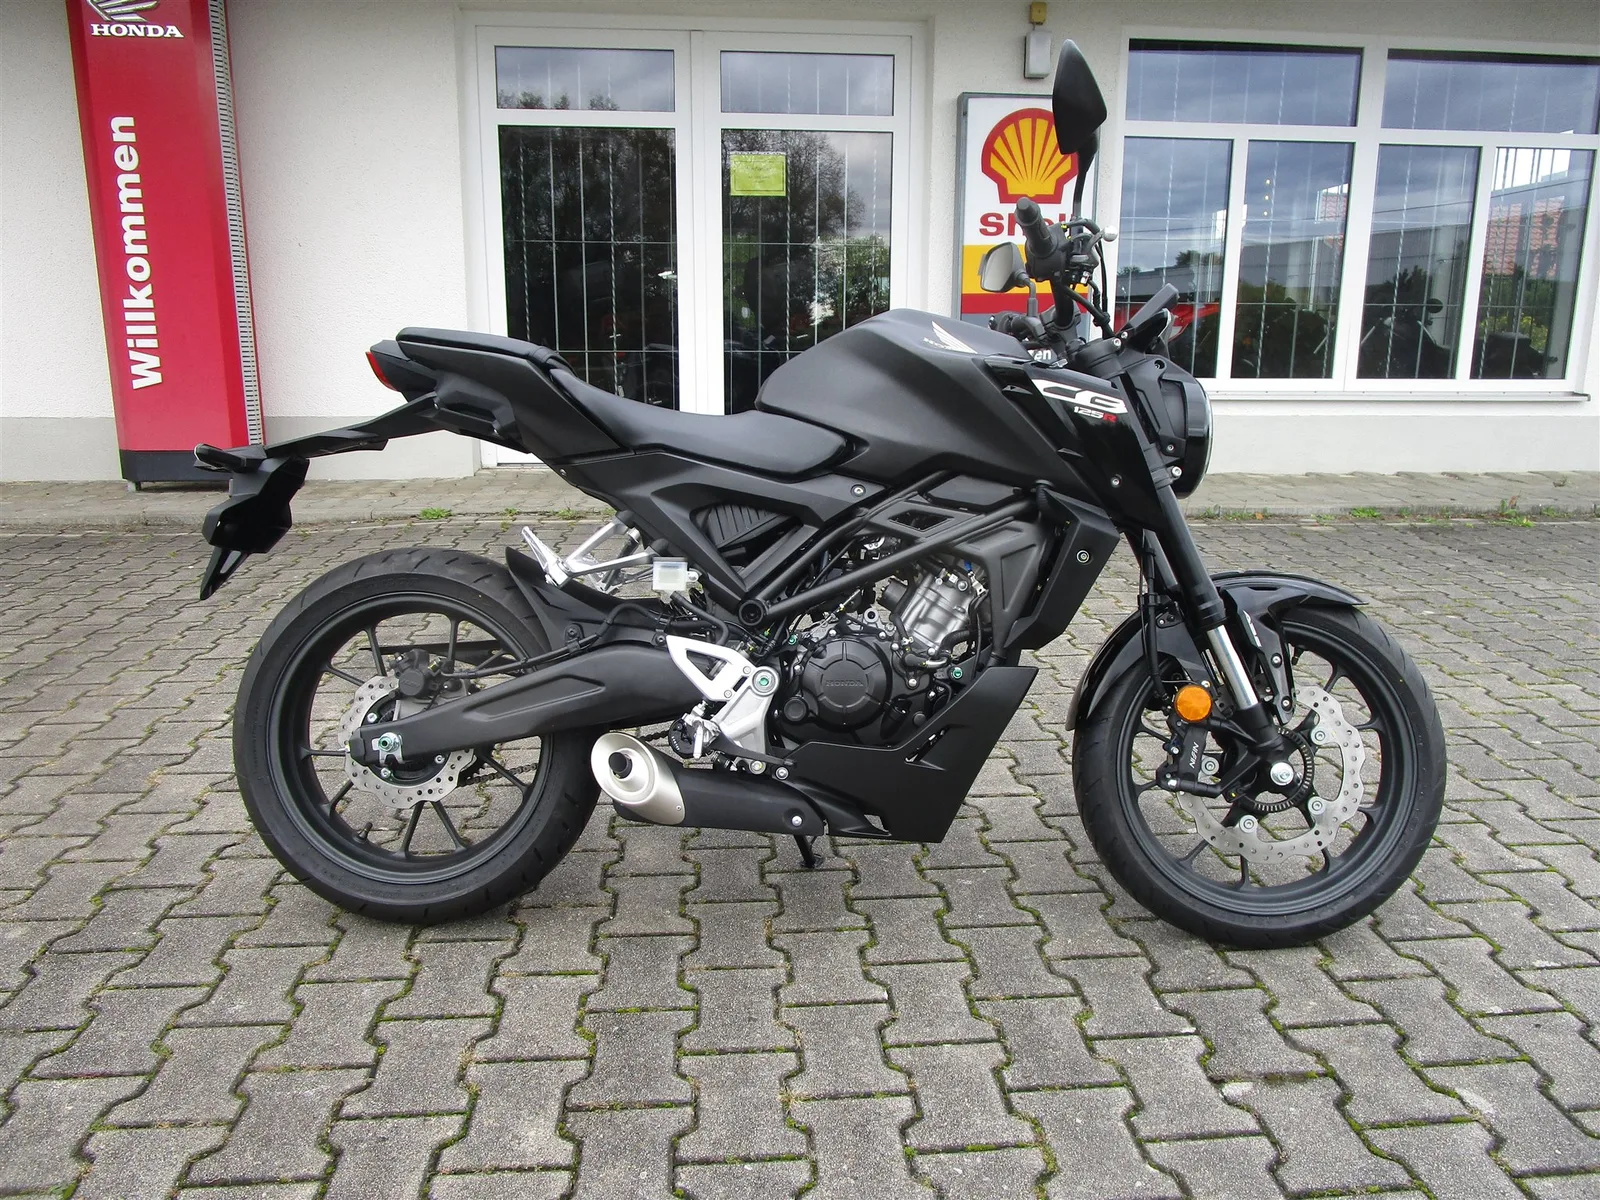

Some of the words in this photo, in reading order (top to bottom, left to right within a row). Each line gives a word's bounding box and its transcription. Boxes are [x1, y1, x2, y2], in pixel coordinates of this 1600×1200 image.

[91, 24, 184, 38] HONDA
[110, 116, 163, 390] Willkommen
[1074, 406, 1117, 422] 125R
[826, 680, 864, 688] HONDA
